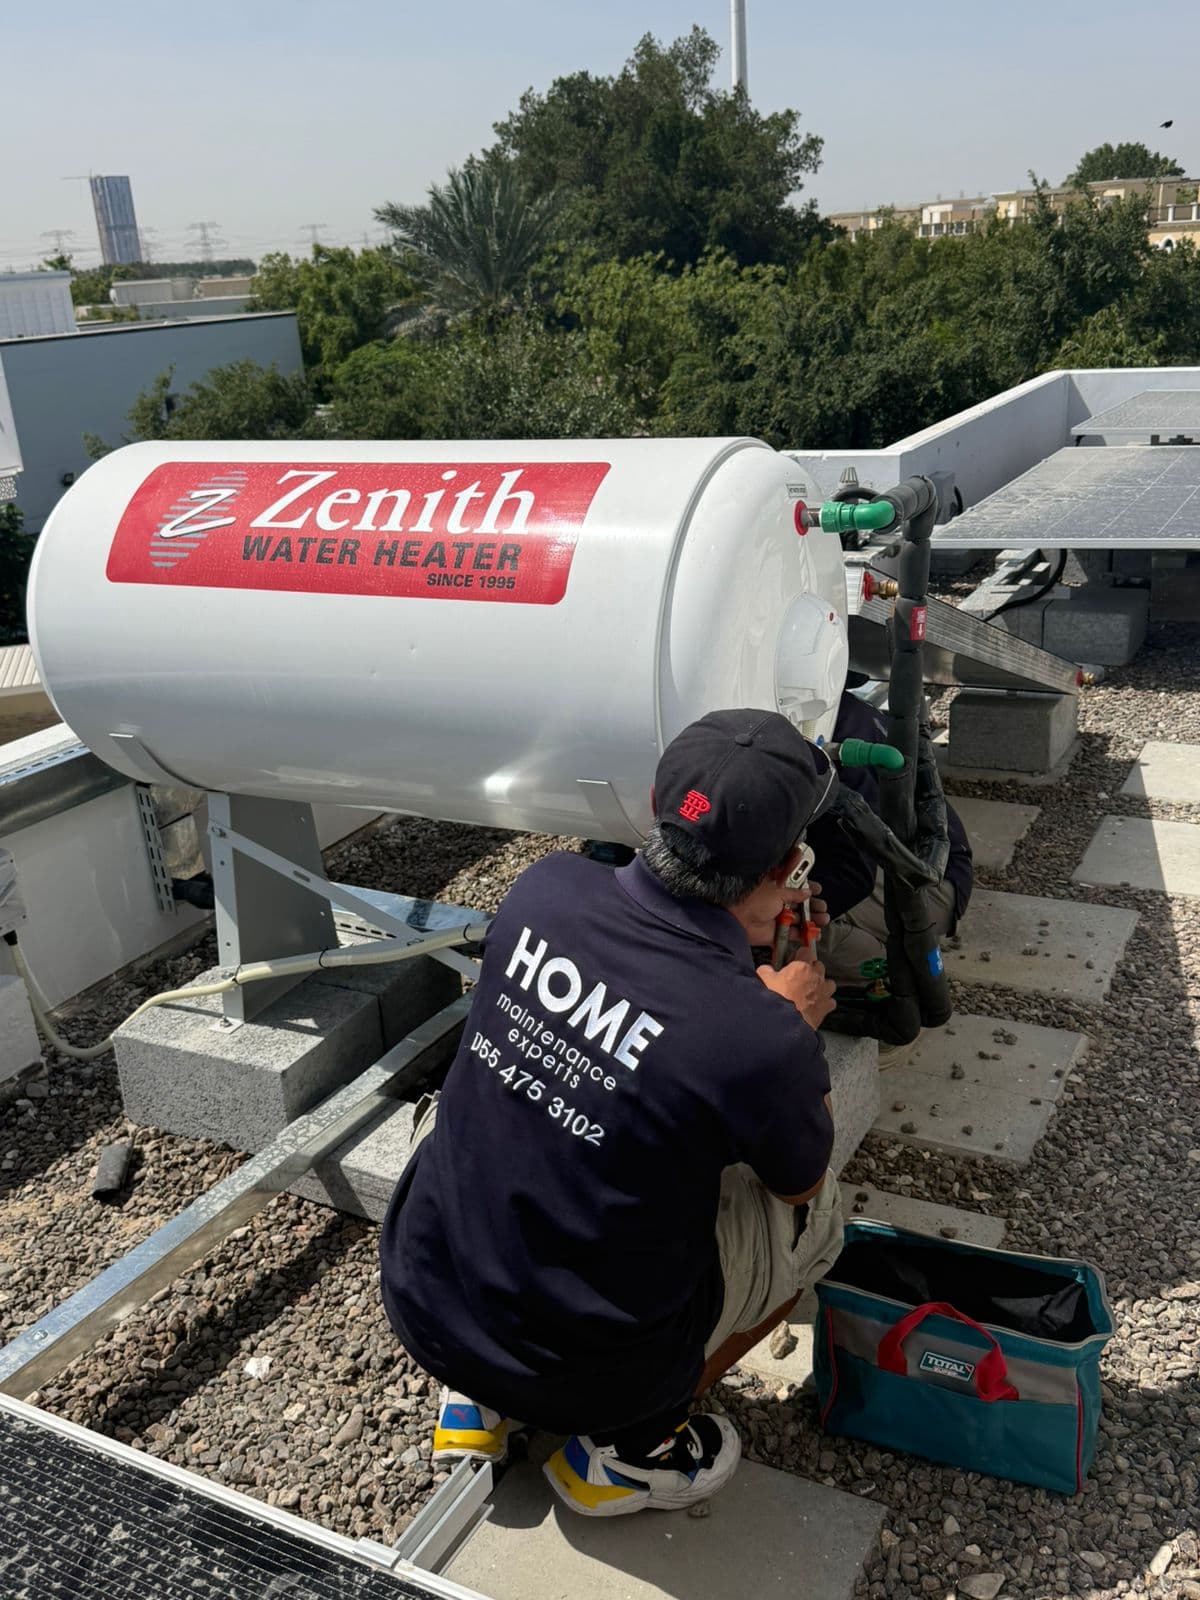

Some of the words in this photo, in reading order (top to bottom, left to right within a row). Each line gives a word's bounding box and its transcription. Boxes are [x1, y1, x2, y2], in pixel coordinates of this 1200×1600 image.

[249, 468, 535, 535] Zenith
[242, 535, 361, 566] WATER
[373, 539, 522, 571] HEATER
[427, 572, 473, 588] SINCE
[479, 575, 516, 590] 1995
[505, 926, 664, 1072] HOME
[496, 993, 617, 1091] maintenance
[508, 1028, 580, 1089] experts
[499, 1064, 546, 1101] 475
[548, 1096, 605, 1147] 3102
[927, 1355, 966, 1374] TOTAL
